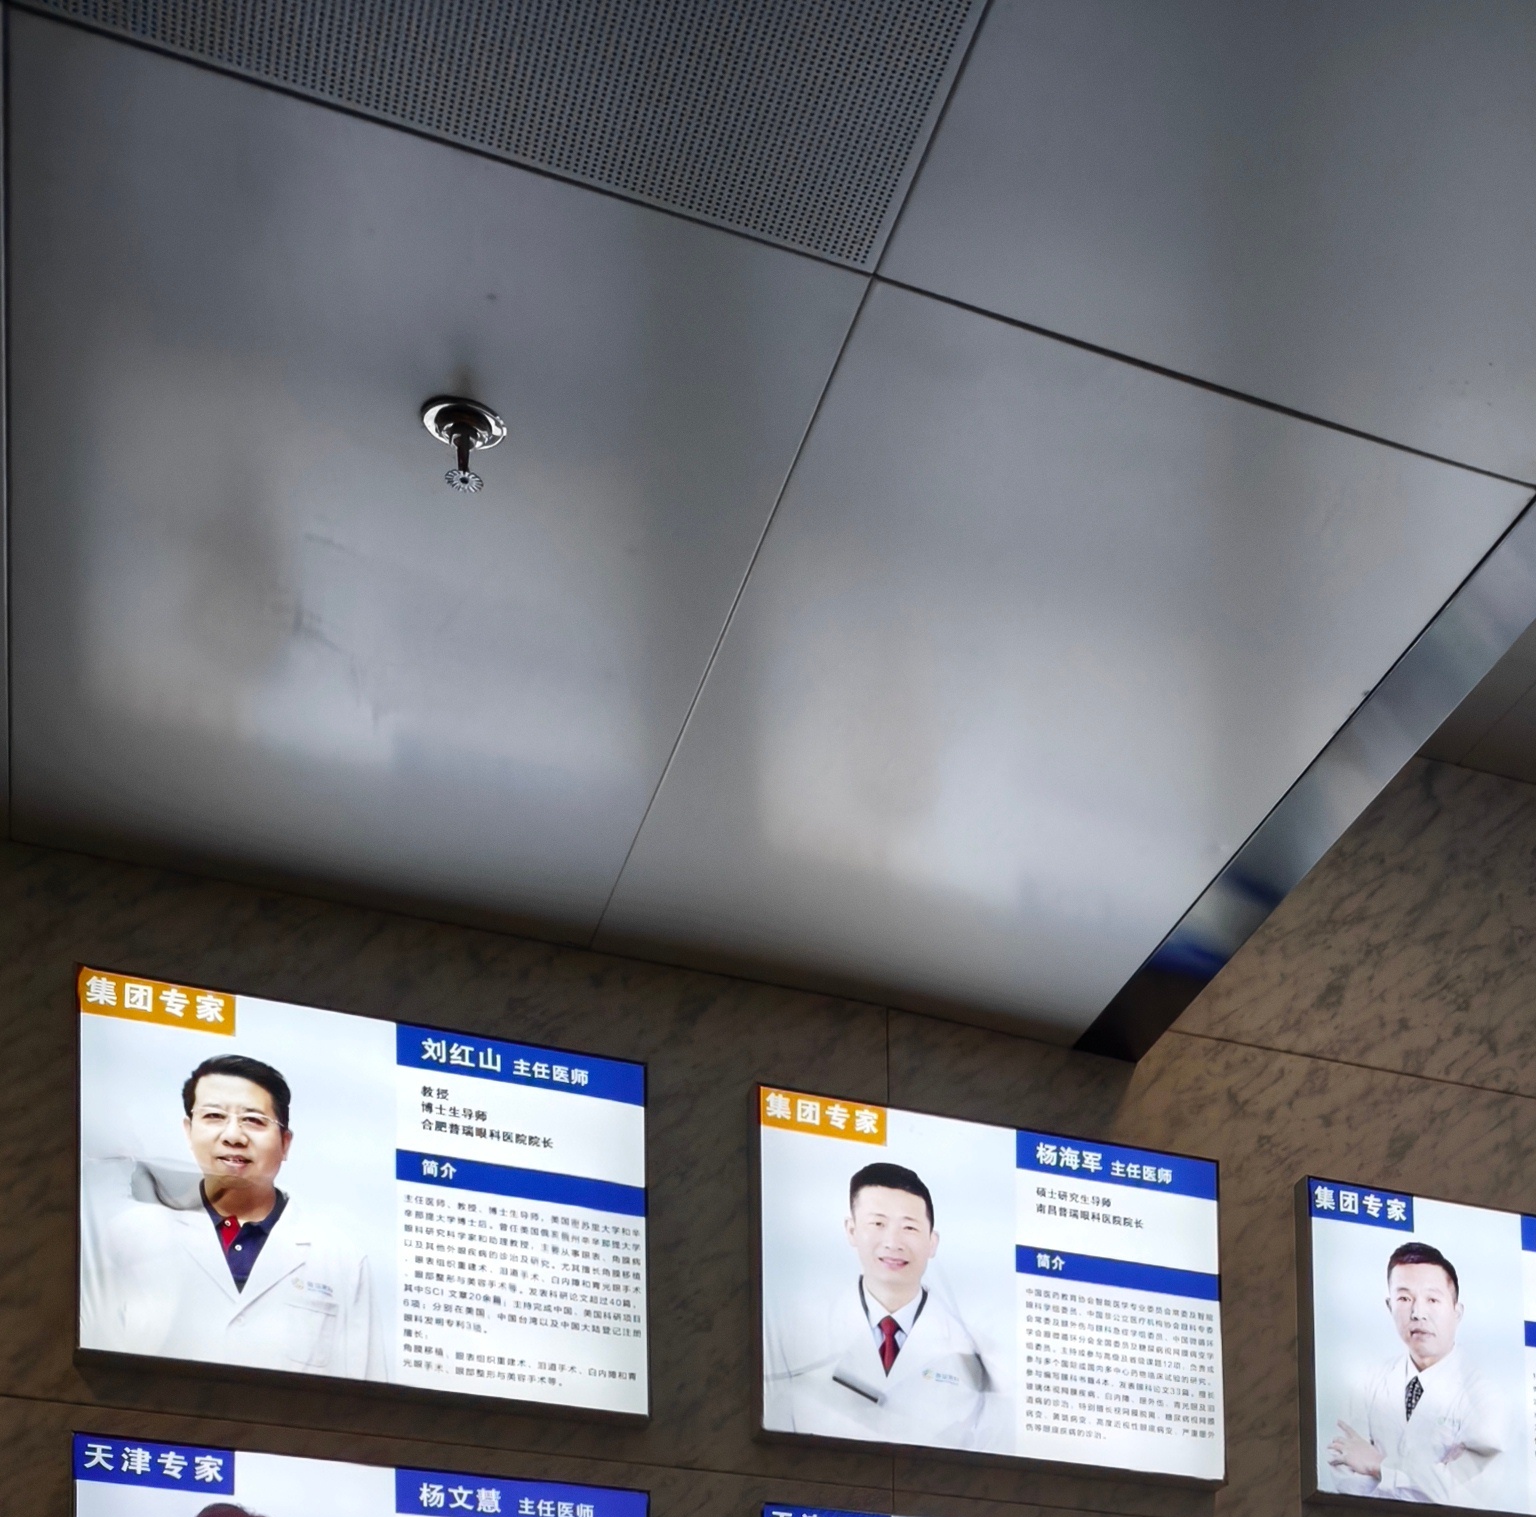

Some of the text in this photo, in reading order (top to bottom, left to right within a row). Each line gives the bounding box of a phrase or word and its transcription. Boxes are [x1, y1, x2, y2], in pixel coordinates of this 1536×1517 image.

[86, 975, 225, 1023] 集团专家
[420, 1037, 589, 1087] 刘红山 主任医师
[420, 1084, 449, 1101] 教授
[420, 1100, 487, 1122] 博士生导师
[766, 1092, 878, 1134] 集团专家
[420, 1117, 553, 1149] 合肥普瑞眼科医院院长
[421, 1158, 457, 1180] 简介
[1035, 1141, 1173, 1185] 杨海军 主任医师
[1035, 1186, 1112, 1208] 硕士研究生导师
[1314, 1185, 1407, 1222] 集团专家
[1035, 1252, 1066, 1271] 简介
[84, 1443, 224, 1483] 天津专家
[418, 1481, 502, 1513] 杨文慧
